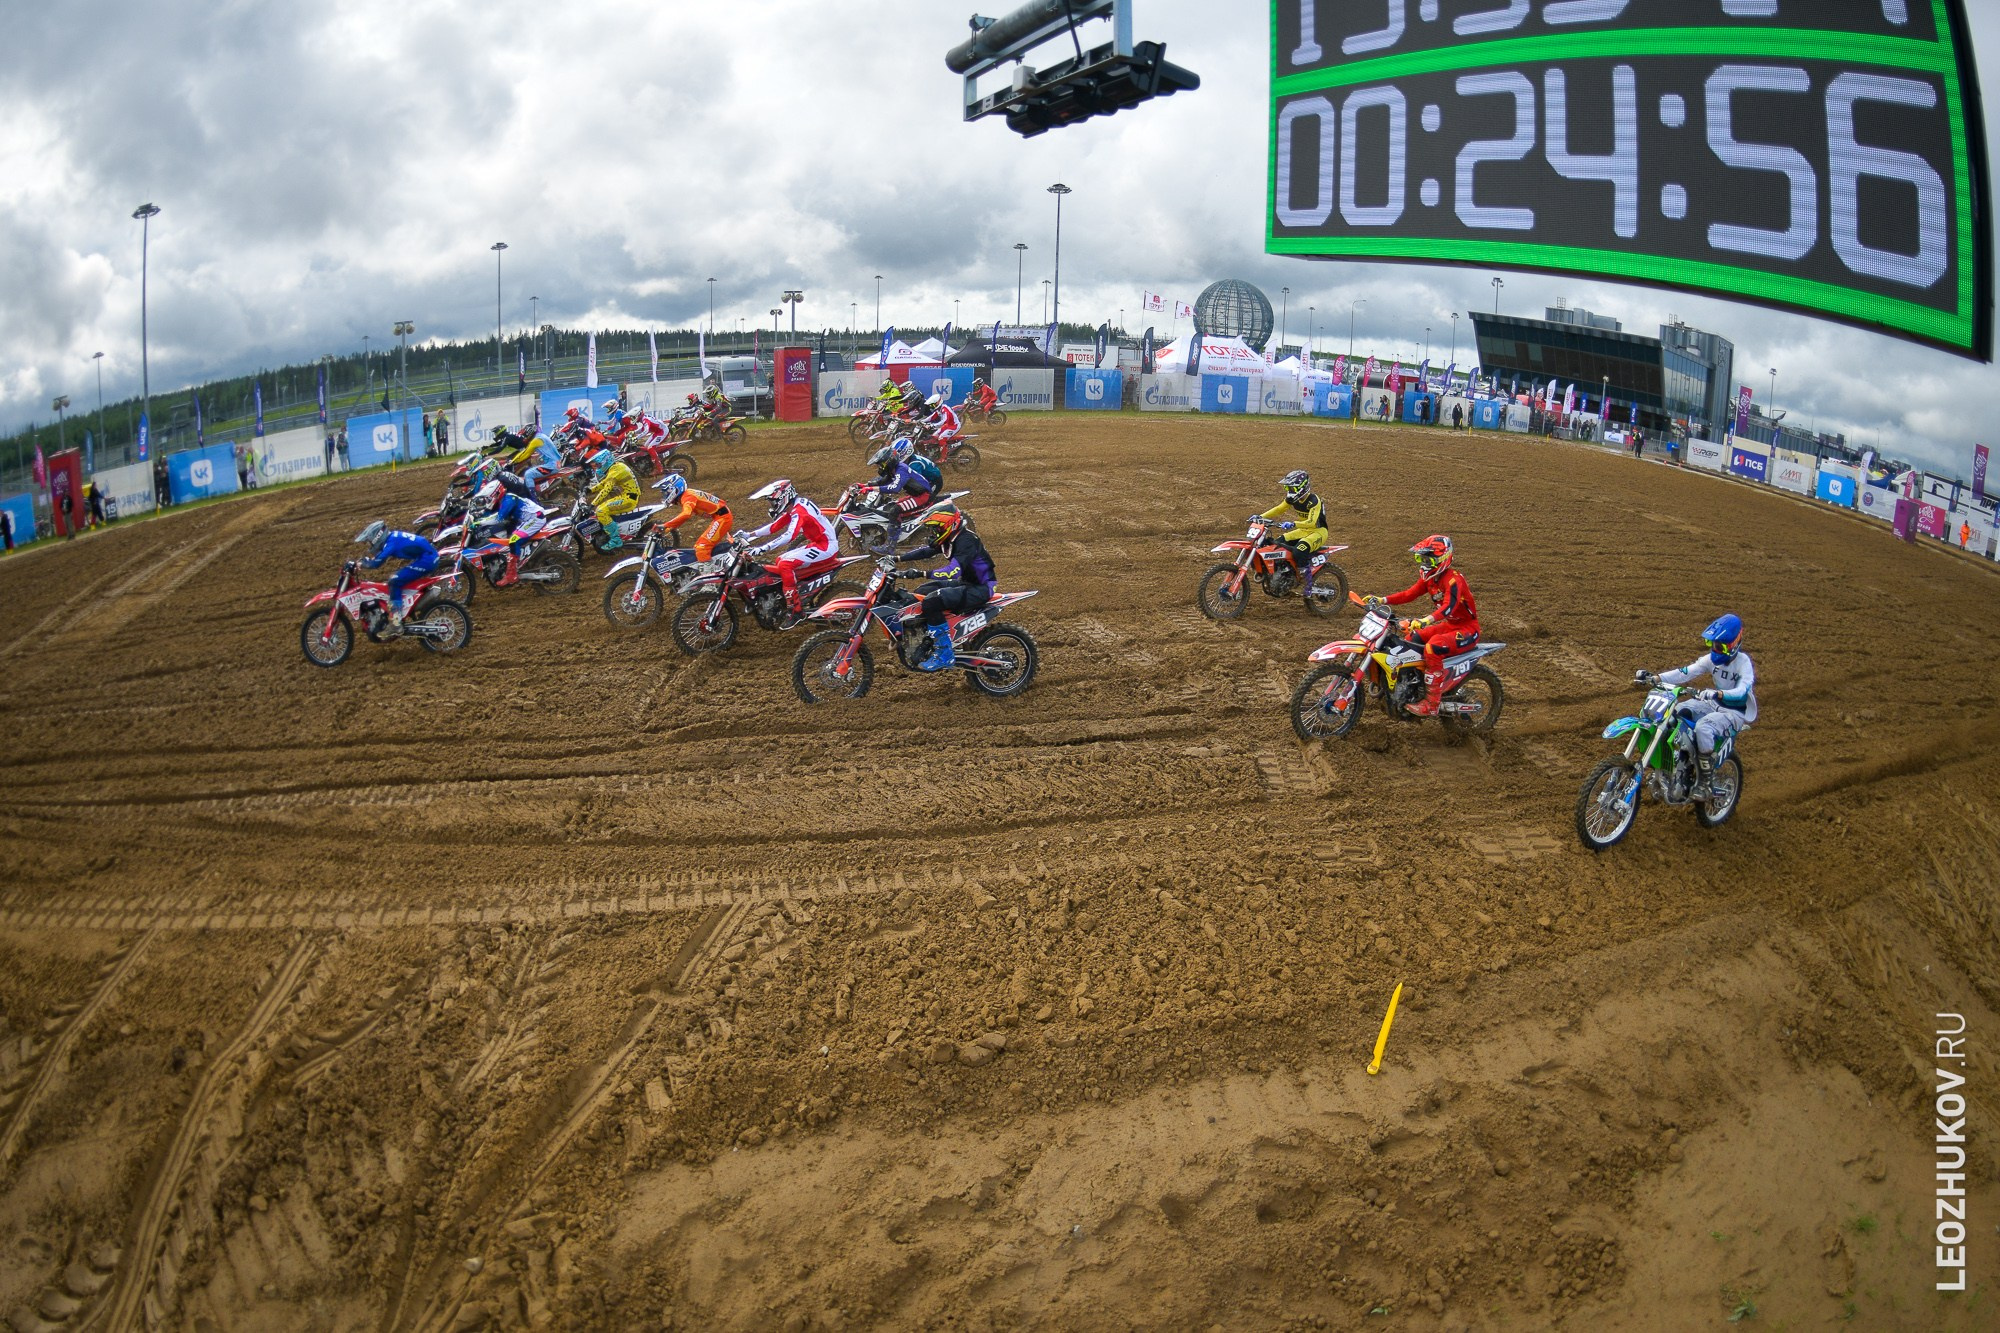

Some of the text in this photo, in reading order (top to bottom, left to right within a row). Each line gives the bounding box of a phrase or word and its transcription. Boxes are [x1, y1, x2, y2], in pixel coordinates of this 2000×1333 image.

[1277, 65, 1947, 288] 00:24:56
[936, 383, 950, 395] VK
[1089, 385, 1101, 395] VK
[1221, 389, 1231, 399] VK
[1013, 393, 1051, 404] ГАЗПРОМ
[1159, 395, 1190, 406] ГАЗПРОМ
[377, 431, 394, 444] VK
[276, 455, 322, 475] ГАЗПРОМ
[1744, 460, 1764, 471] ПСБ
[193, 467, 210, 480] VK
[1831, 483, 1840, 492] VK
[106, 503, 117, 515] 15
[628, 521, 642, 533] 96
[1246, 528, 1260, 539] 99
[1311, 554, 1326, 567] 99
[807, 574, 831, 592] 778
[960, 612, 987, 636] 732
[1453, 659, 1471, 677] 797
[1712, 665, 1742, 682] FOX
